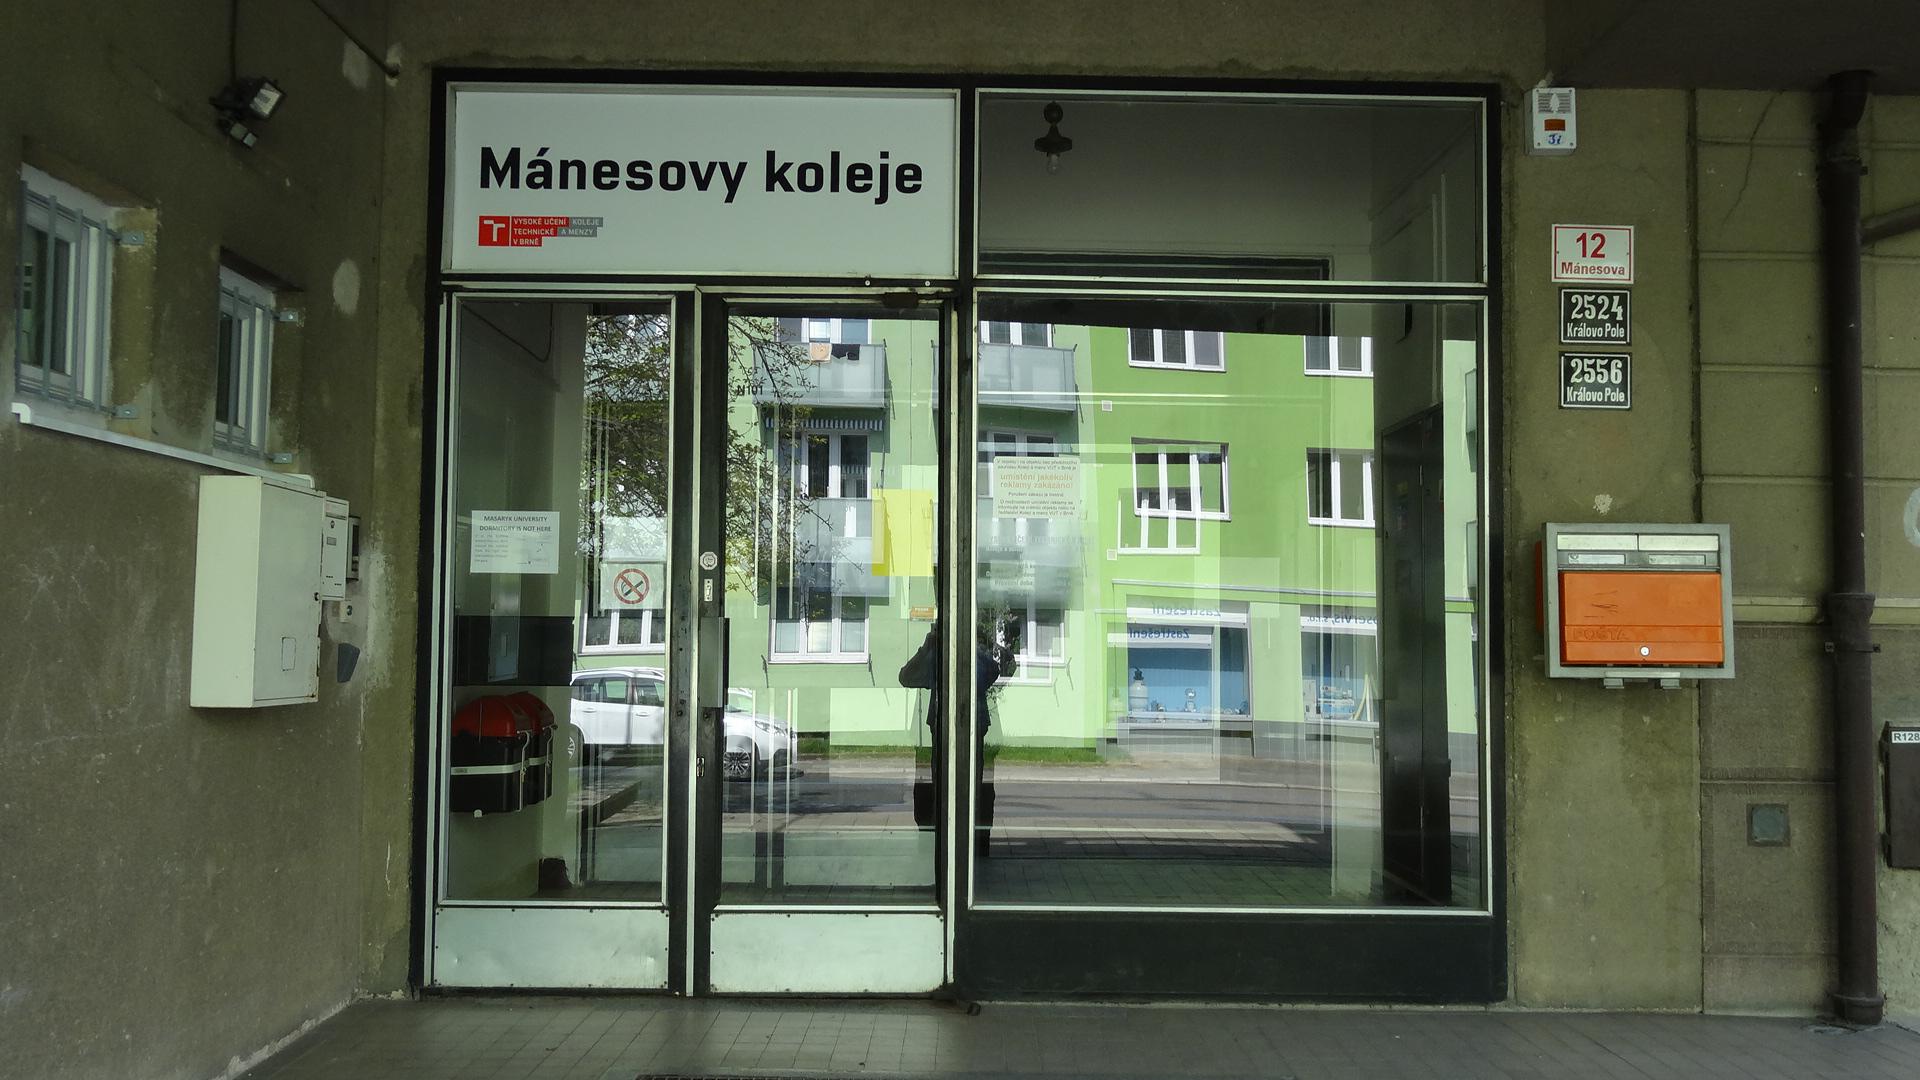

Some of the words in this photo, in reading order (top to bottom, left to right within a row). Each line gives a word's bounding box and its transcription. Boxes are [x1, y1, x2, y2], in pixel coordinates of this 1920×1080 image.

[479, 146, 748, 203] Mánesovy
[765, 150, 924, 205] koleje
[513, 217, 542, 225] VYSOKÉ
[544, 217, 566, 226] UČENÍ
[572, 218, 599, 226] KOLEJE
[513, 227, 555, 235] TECHNICKÉ
[519, 237, 539, 245] BRNĚ
[1575, 232, 1606, 259] 12
[1561, 262, 1625, 276] Mánesova
[1570, 294, 1624, 321] 2524
[1566, 322, 1603, 338] Královo
[1605, 323, 1625, 338] Pole
[1570, 358, 1623, 384] 2556
[737, 385, 763, 395] N101
[1566, 387, 1603, 403] Královo
[1605, 387, 1625, 403] Pole
[1000, 481, 1032, 490] reklamy
[1894, 732, 1920, 741] R128
